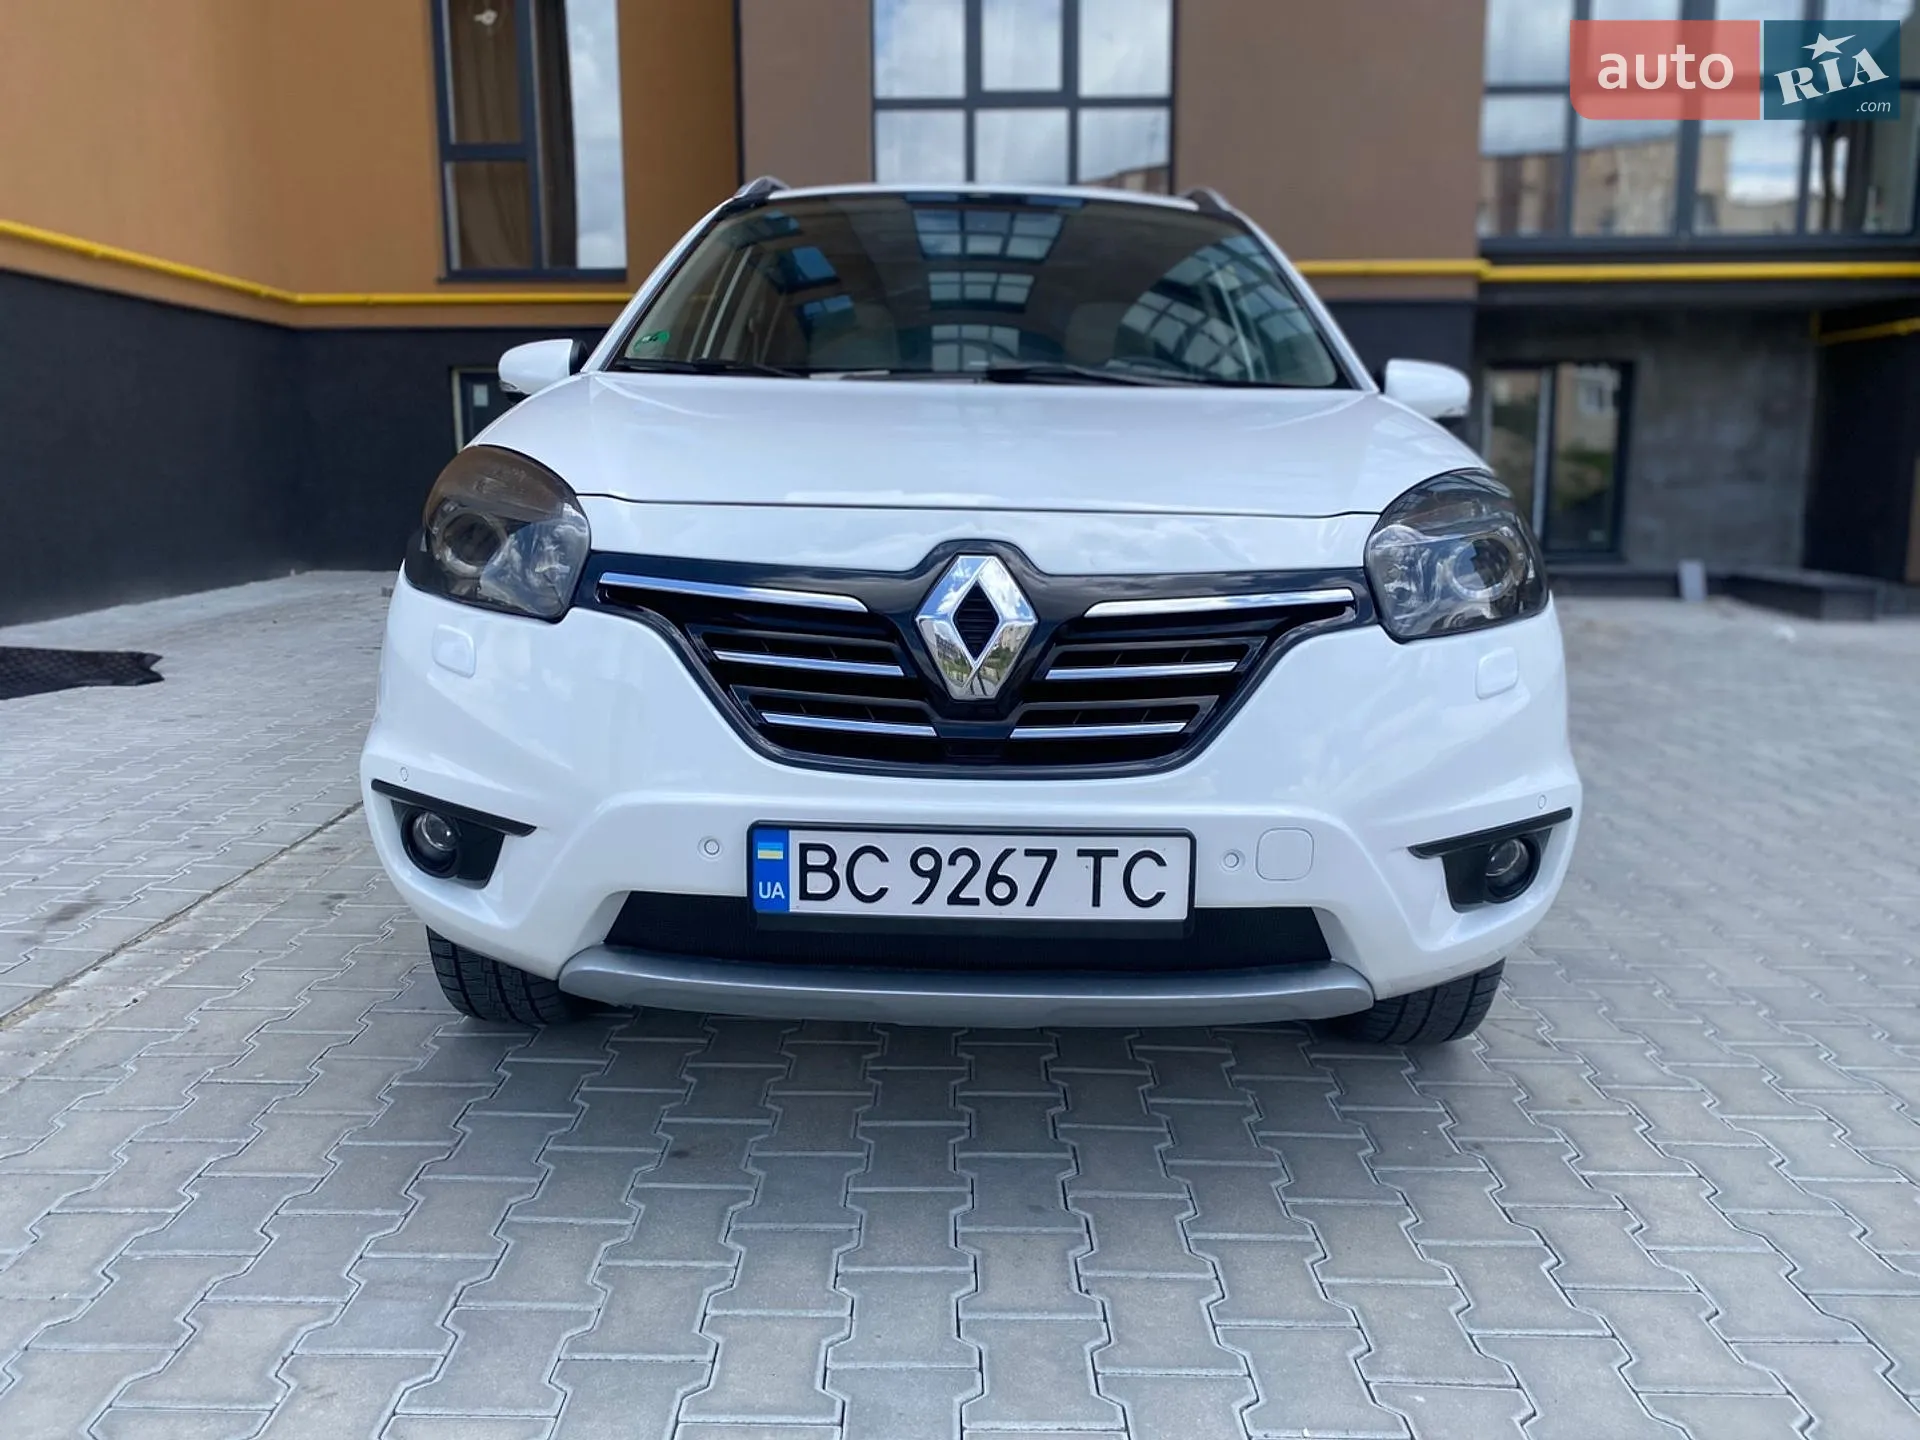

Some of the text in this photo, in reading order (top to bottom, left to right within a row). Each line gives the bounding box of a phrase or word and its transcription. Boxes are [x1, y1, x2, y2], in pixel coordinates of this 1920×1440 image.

[758, 881, 786, 900] UA
[798, 842, 1168, 908] BC 9267 TC
